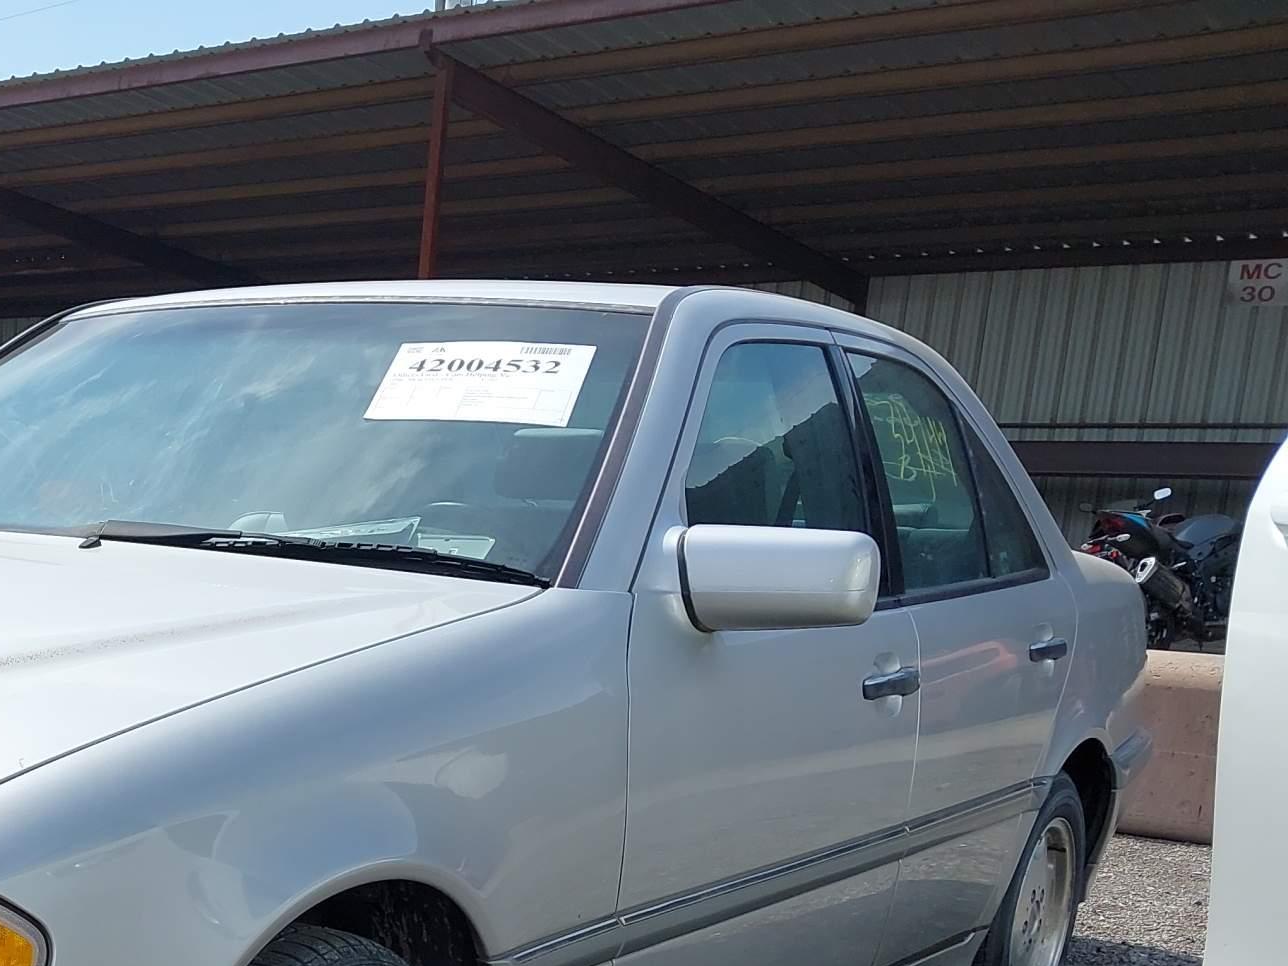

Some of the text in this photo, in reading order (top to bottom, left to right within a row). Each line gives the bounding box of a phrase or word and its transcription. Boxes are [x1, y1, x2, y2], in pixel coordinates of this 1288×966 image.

[1239, 262, 1284, 280] MC
[1239, 285, 1276, 303] 30
[408, 357, 562, 374] 42004532
